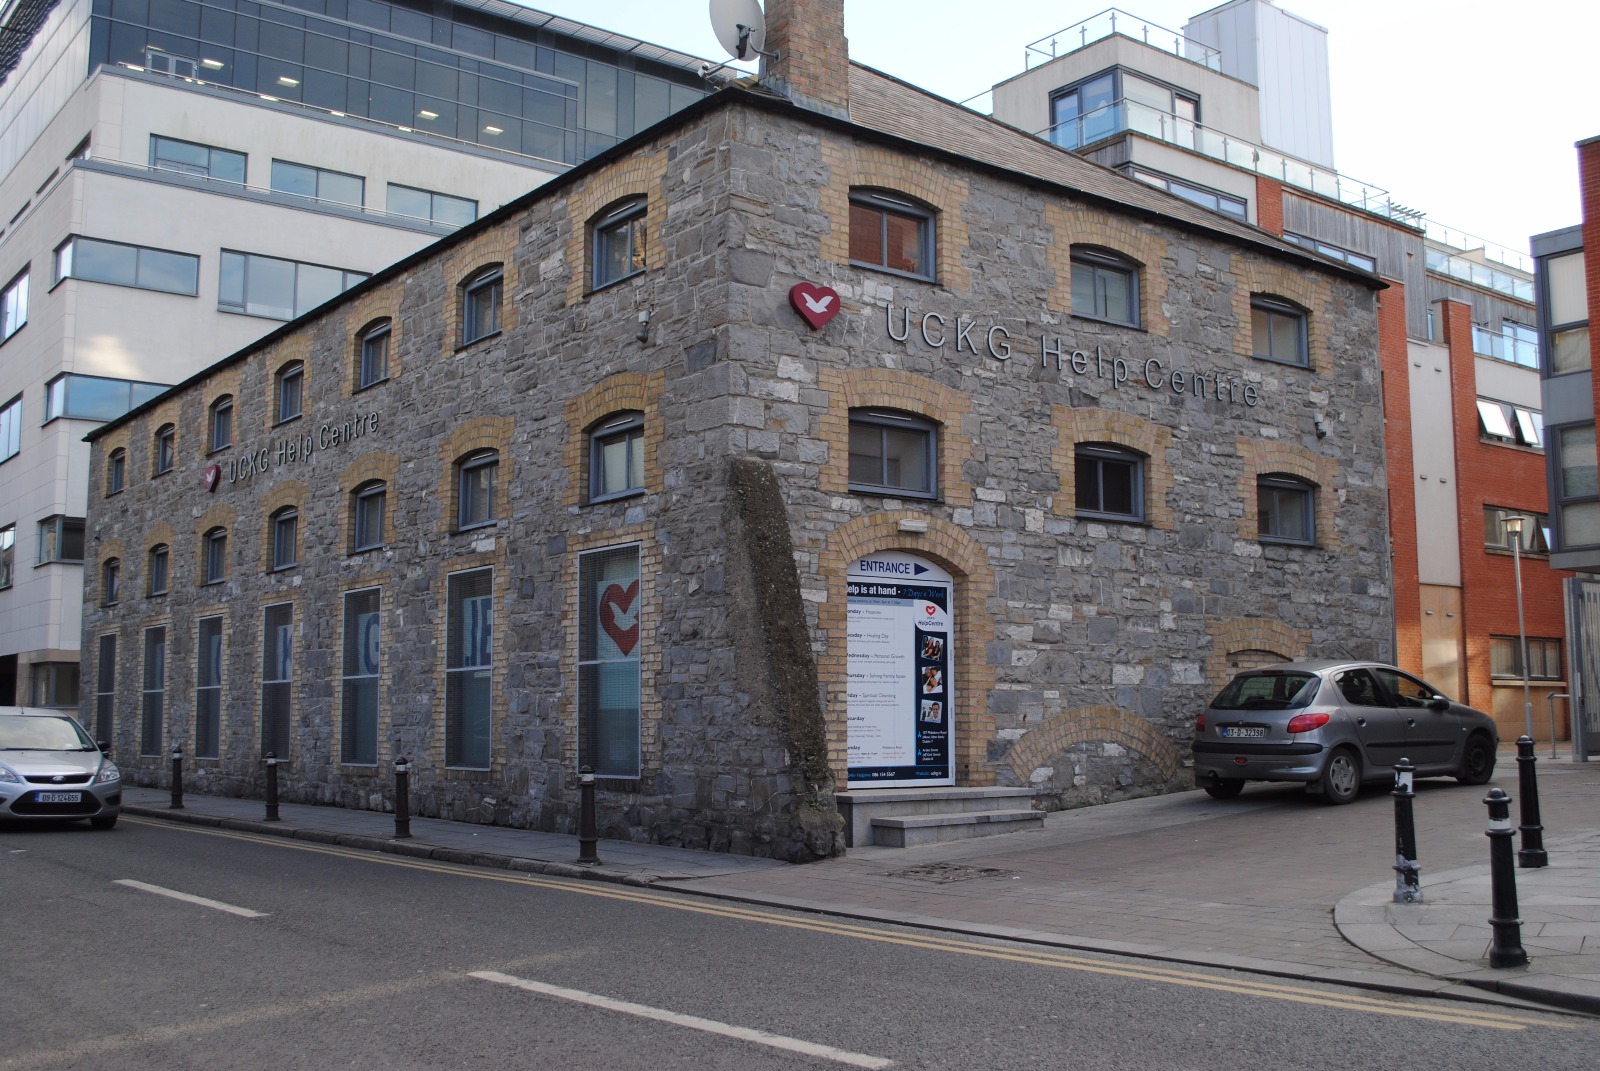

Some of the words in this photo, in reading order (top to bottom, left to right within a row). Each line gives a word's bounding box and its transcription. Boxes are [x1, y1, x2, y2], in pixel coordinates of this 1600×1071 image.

[885, 303, 1011, 361] UCKG
[1040, 334, 1127, 388] Help
[1144, 358, 1259, 408] Centre
[229, 447, 270, 483] UCKG
[277, 434, 313, 466] Help
[320, 411, 379, 450] Centre
[860, 560, 910, 574] ENTRANCE
[847, 585, 859, 594] elp
[861, 585, 867, 594] is
[869, 586, 877, 594] at
[878, 586, 896, 595] hand
[908, 589, 921, 600] Days
[928, 589, 945, 598] Week
